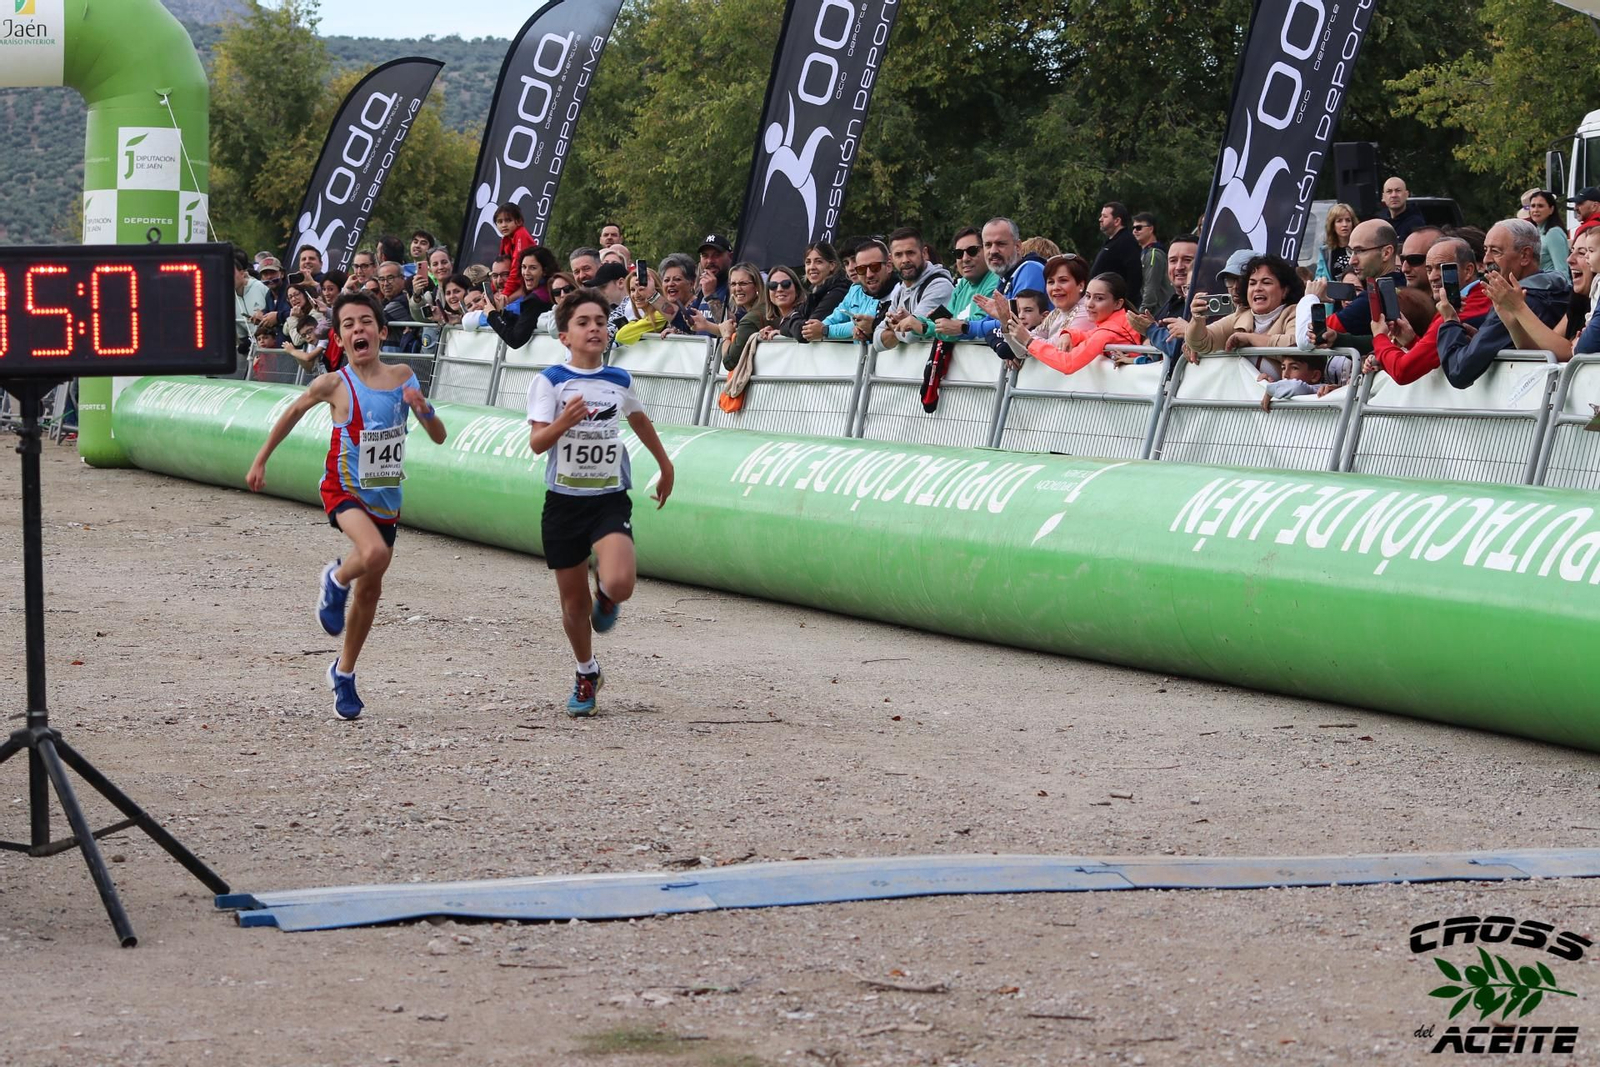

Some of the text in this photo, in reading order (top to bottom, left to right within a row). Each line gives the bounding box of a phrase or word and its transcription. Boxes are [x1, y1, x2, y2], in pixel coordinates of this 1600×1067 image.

[3, 18, 47, 38] Jaén
[136, 154, 175, 162] DIPUTACIÓN
[366, 440, 404, 464] 140
[563, 443, 617, 464] 1505
[730, 442, 1046, 513] DIPUTACIÓN DE JAÉN
[1168, 478, 1304, 552] JAÉN
[1274, 486, 1376, 548] DE
